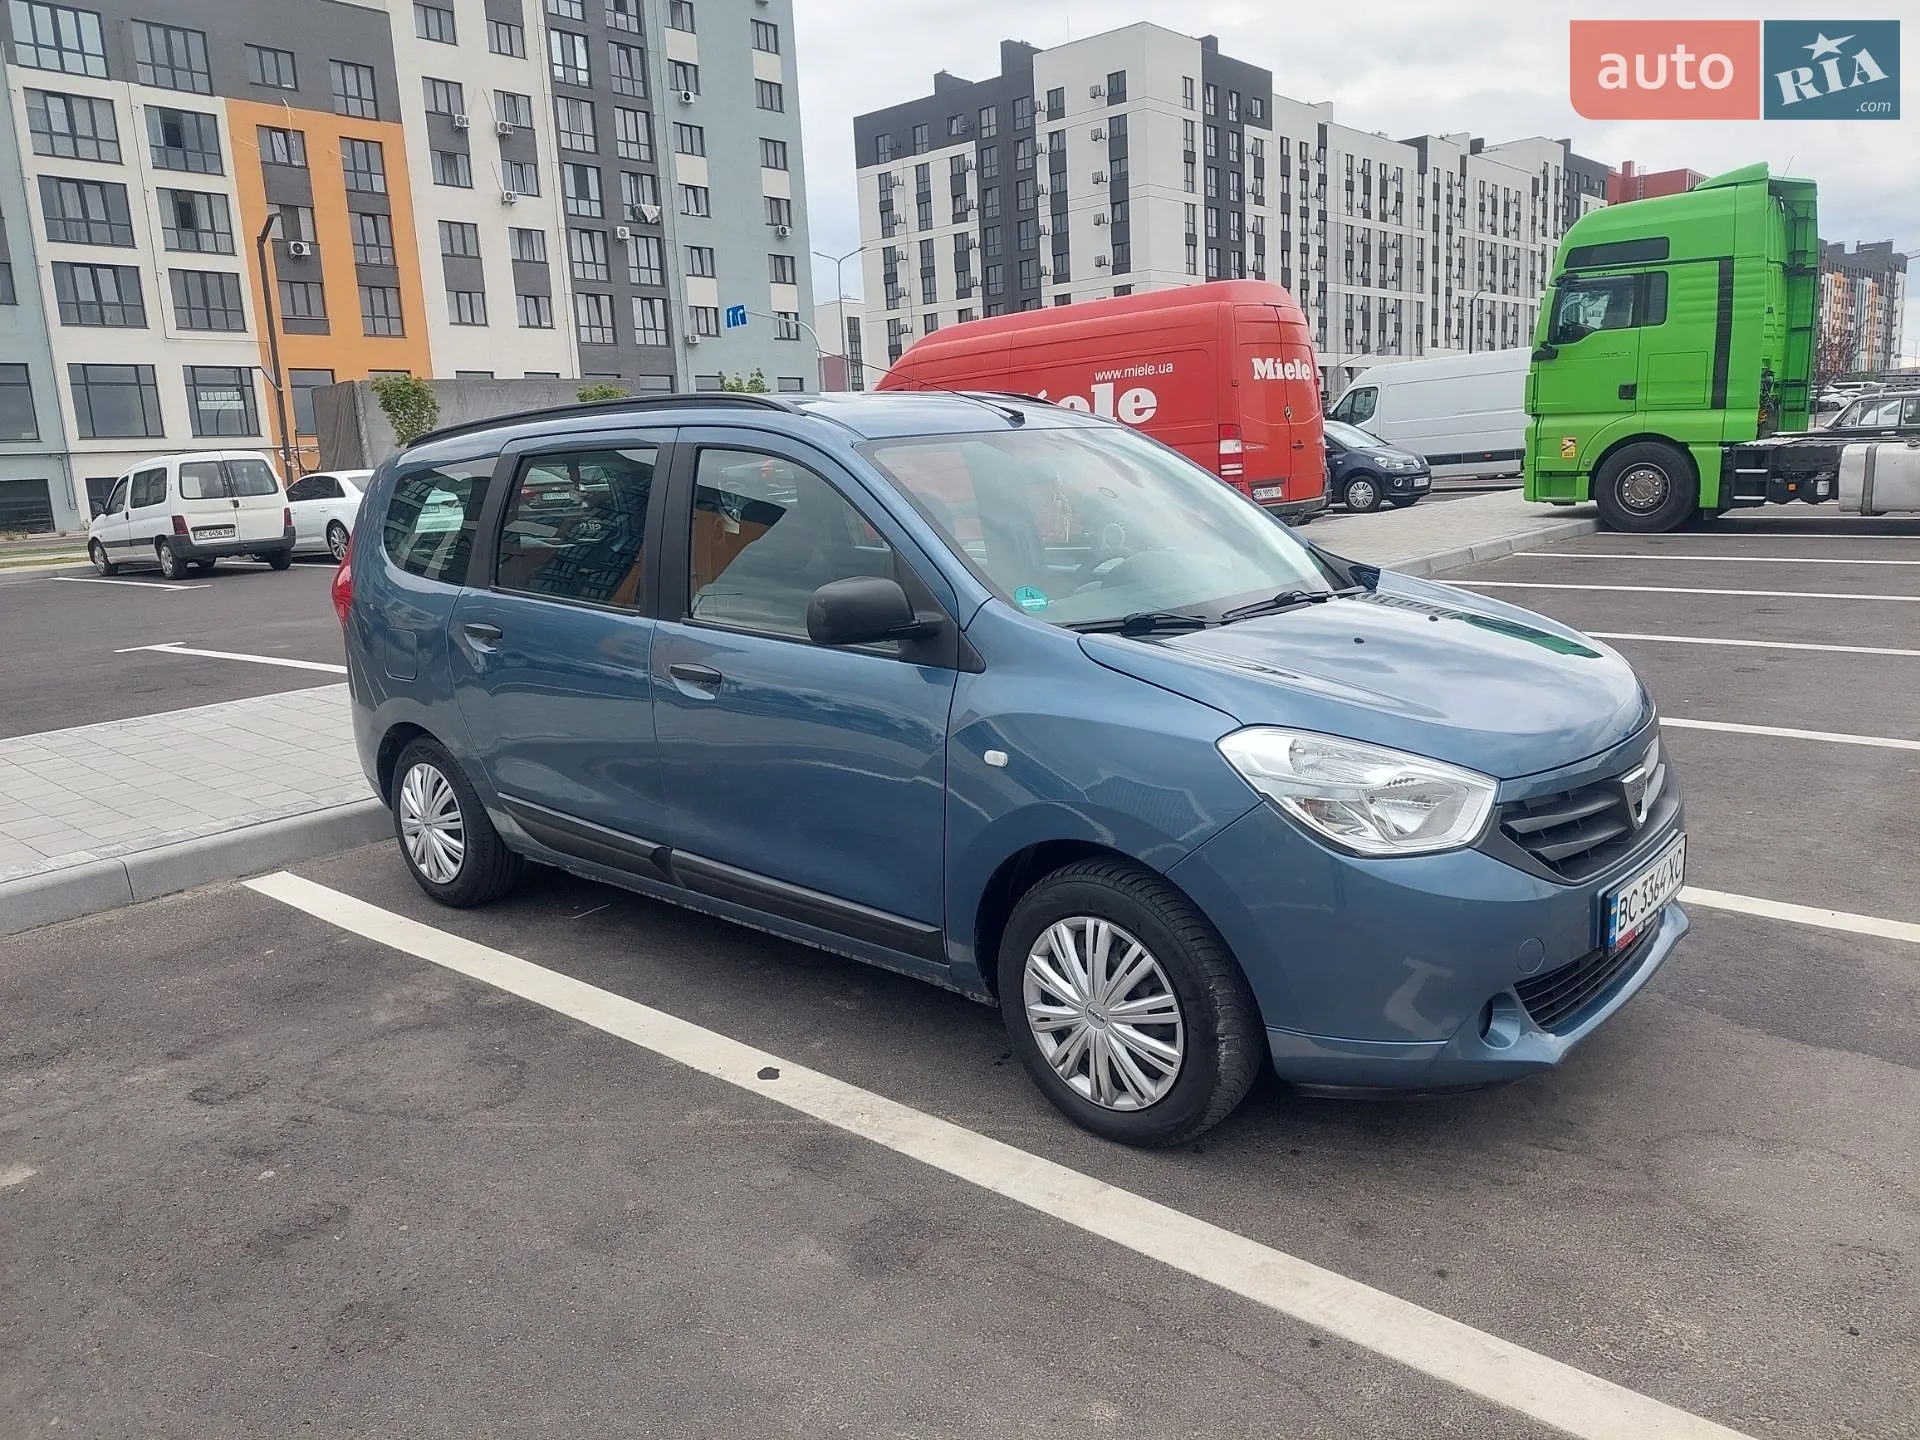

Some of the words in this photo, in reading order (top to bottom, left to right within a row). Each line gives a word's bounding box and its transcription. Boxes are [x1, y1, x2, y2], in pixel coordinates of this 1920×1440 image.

[1094, 363, 1174, 381] www.miele.ua
[1252, 358, 1310, 380] Miele
[1618, 889, 1637, 932] BC
[1640, 861, 1667, 914] 3364
[1668, 848, 1682, 889] XC
